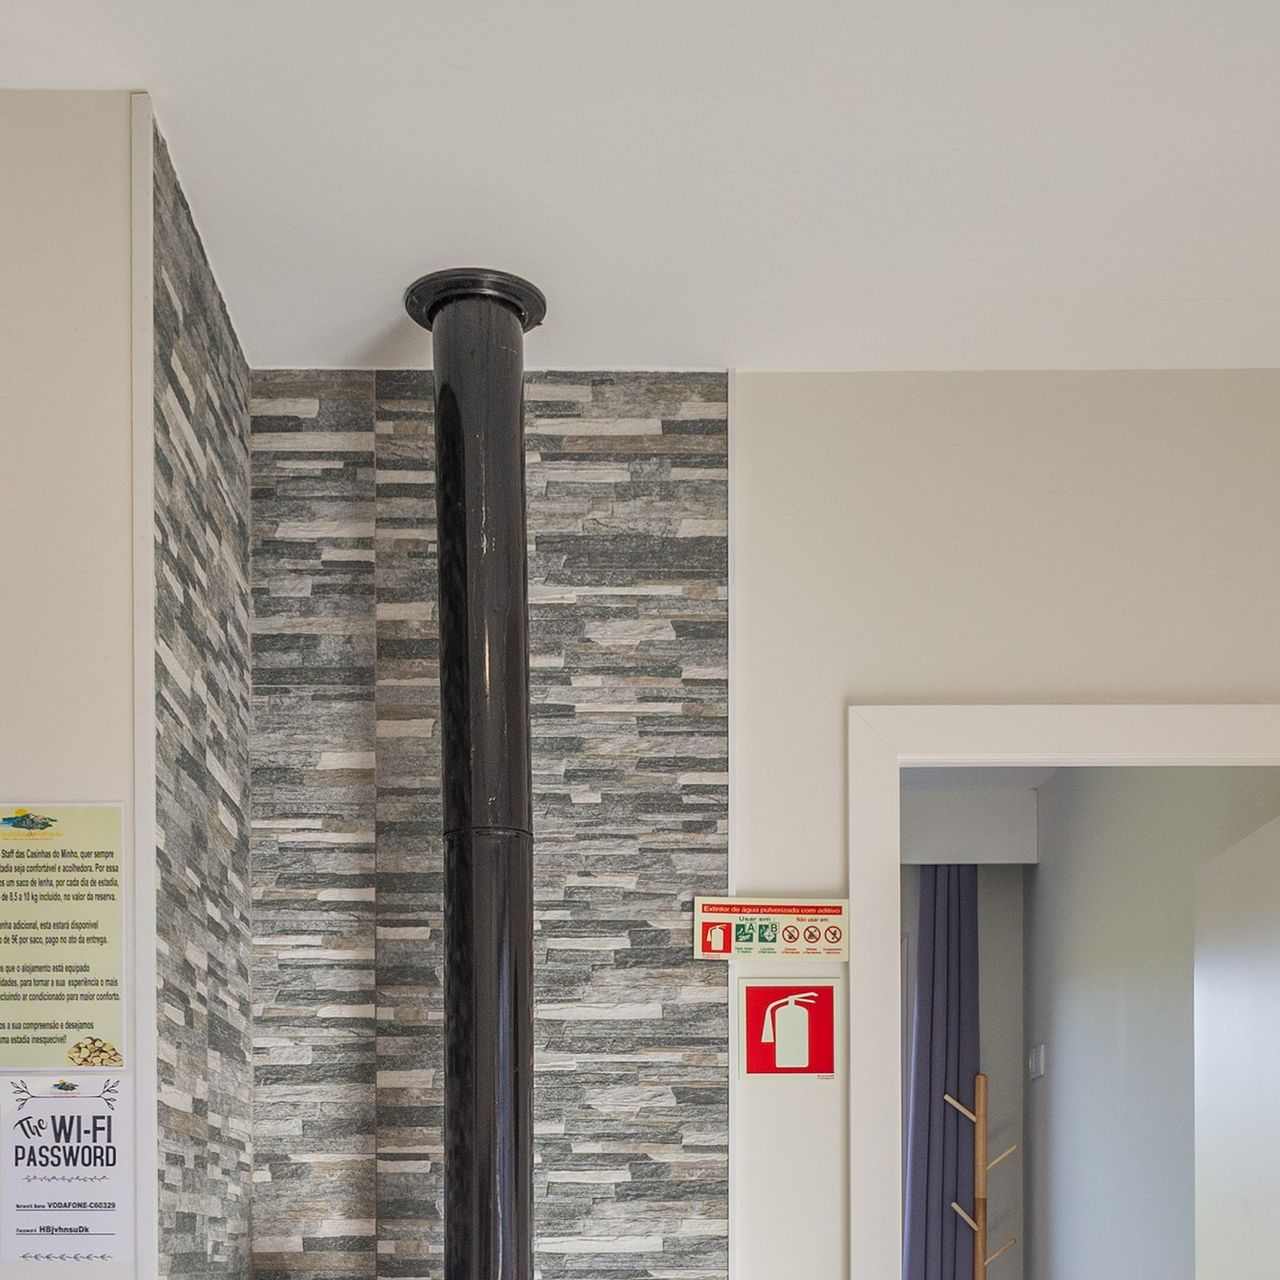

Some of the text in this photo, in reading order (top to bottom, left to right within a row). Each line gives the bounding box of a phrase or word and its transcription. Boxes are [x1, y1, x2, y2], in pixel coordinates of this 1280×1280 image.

[760, 906, 799, 914] pulverizada
[747, 923, 755, 931] A
[771, 923, 778, 932] B
[13, 1115, 112, 1143] The WI-FI
[14, 1145, 117, 1167] PASSWORD
